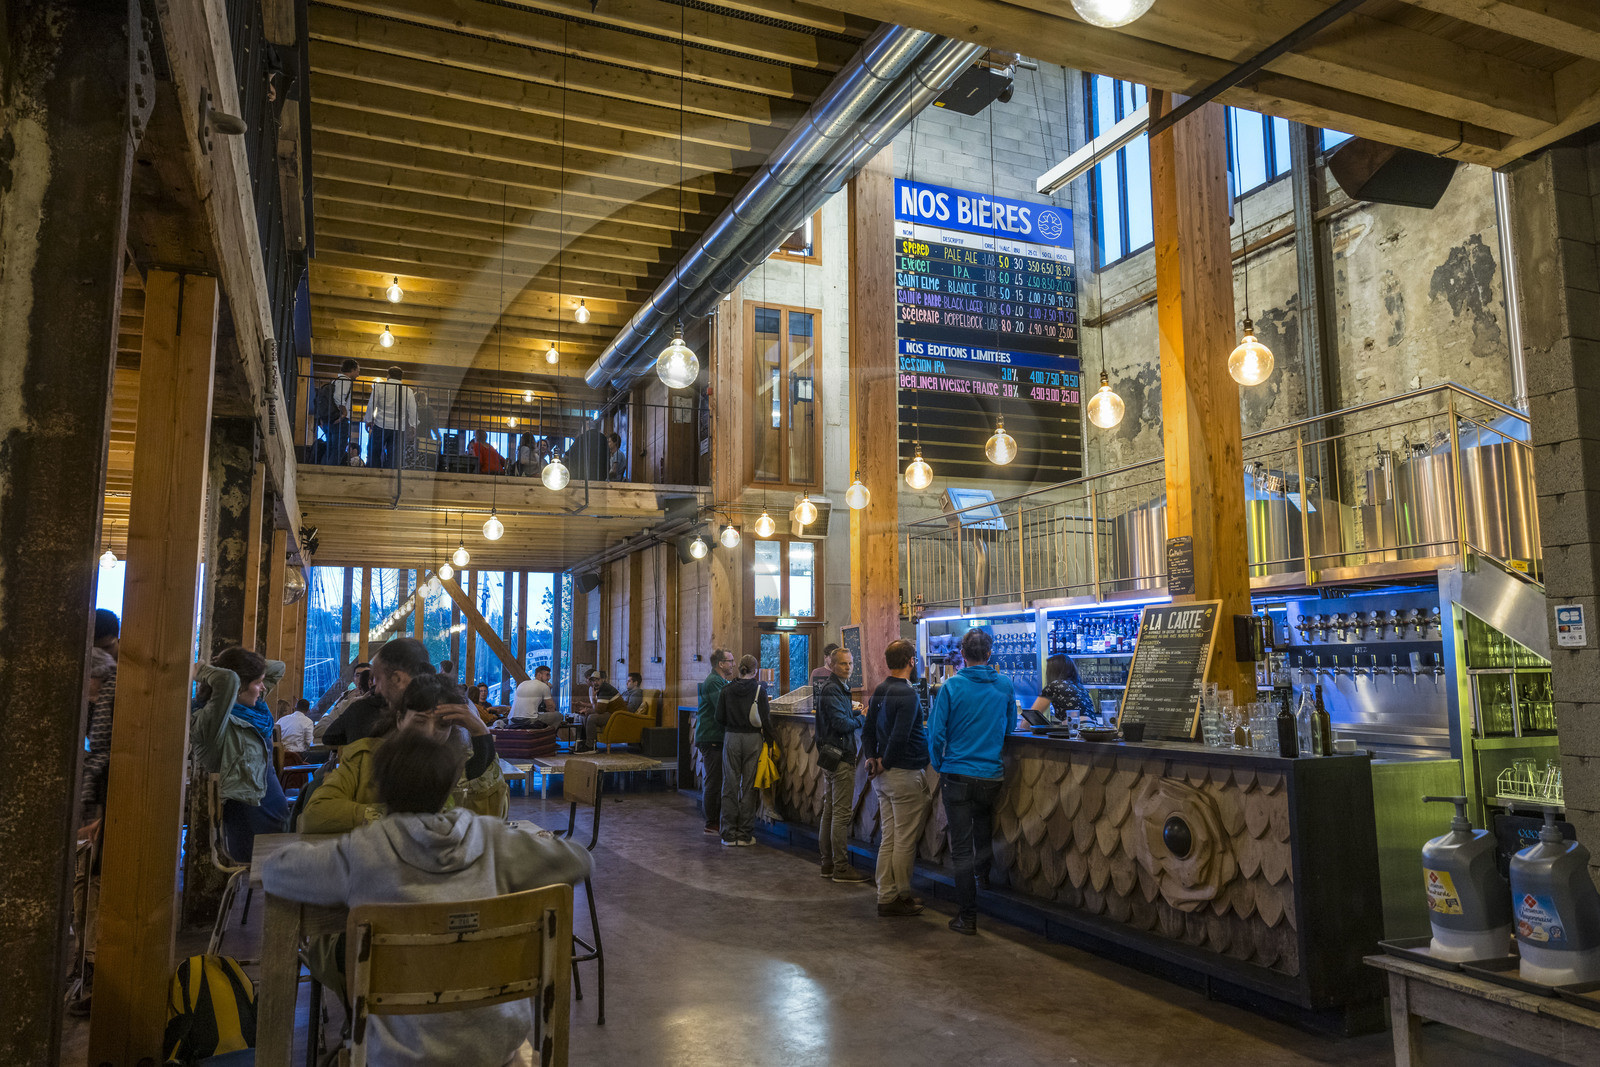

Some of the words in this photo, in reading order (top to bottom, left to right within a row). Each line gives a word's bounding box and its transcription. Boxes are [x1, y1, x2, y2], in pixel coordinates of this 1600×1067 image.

[901, 186, 950, 221] NOS
[957, 196, 1032, 235] BIÈRES
[942, 236, 964, 244] DESCRIPTIF
[944, 246, 962, 262] PALE
[964, 250, 978, 264] ALE
[999, 255, 1009, 268] 5.0
[1014, 258, 1023, 270] 30
[1041, 262, 1054, 274] 6.50
[898, 273, 919, 288] SAINT
[1000, 287, 1010, 300] 5.0
[1015, 290, 1023, 301] 15
[999, 272, 1009, 284] 6.0
[1014, 274, 1023, 286] 45
[944, 296, 964, 310] BLACK
[966, 299, 983, 312] LAGER
[1000, 304, 1011, 316] 6.0
[1015, 306, 1023, 316] 40
[944, 312, 983, 329] DOPPELBOCK
[1001, 319, 1011, 332] 8.0
[1015, 321, 1024, 333] 20
[906, 342, 924, 354] NOS
[928, 344, 968, 358] ÉDITIONS
[934, 360, 946, 374] IPA
[1149, 614, 1162, 630] LA
[1167, 610, 1204, 630] CARTE
